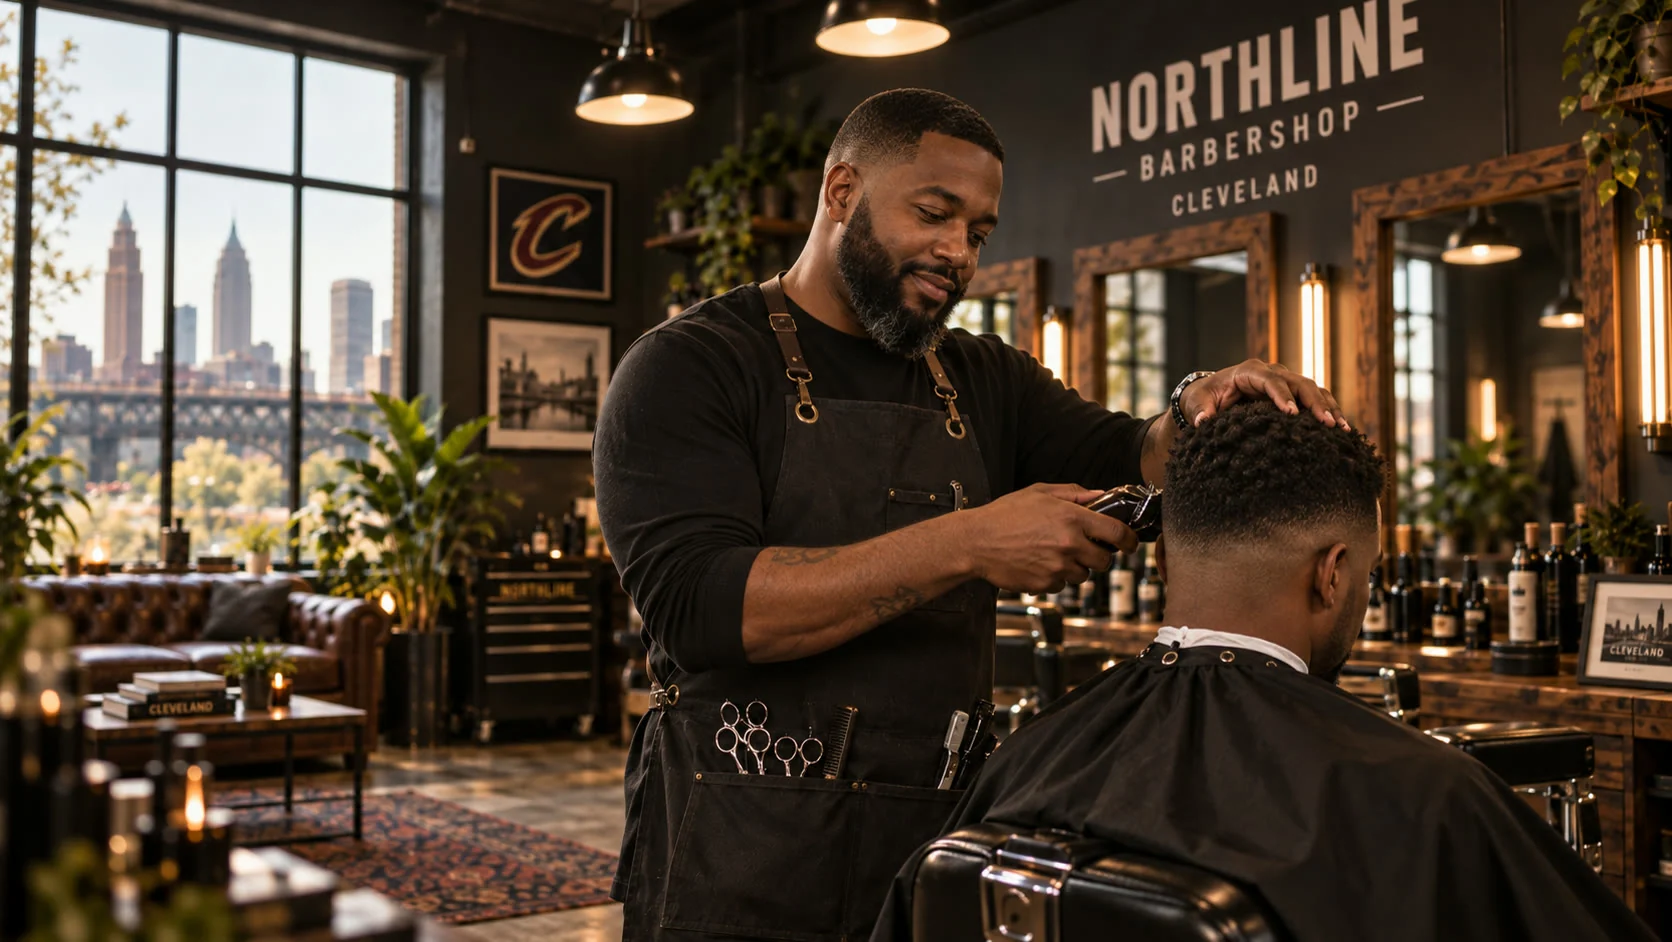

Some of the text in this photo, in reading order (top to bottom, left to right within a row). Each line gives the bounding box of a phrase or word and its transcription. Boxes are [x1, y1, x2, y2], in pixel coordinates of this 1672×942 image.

[1092, 0, 1424, 153] NORTHLINE
[1140, 101, 1359, 181] BARBERSHOP
[1171, 165, 1318, 217] CLEVELAND
[510, 193, 591, 277] C
[1609, 645, 1664, 657] CLEVELAND
[149, 701, 214, 715] CLEVELAND
